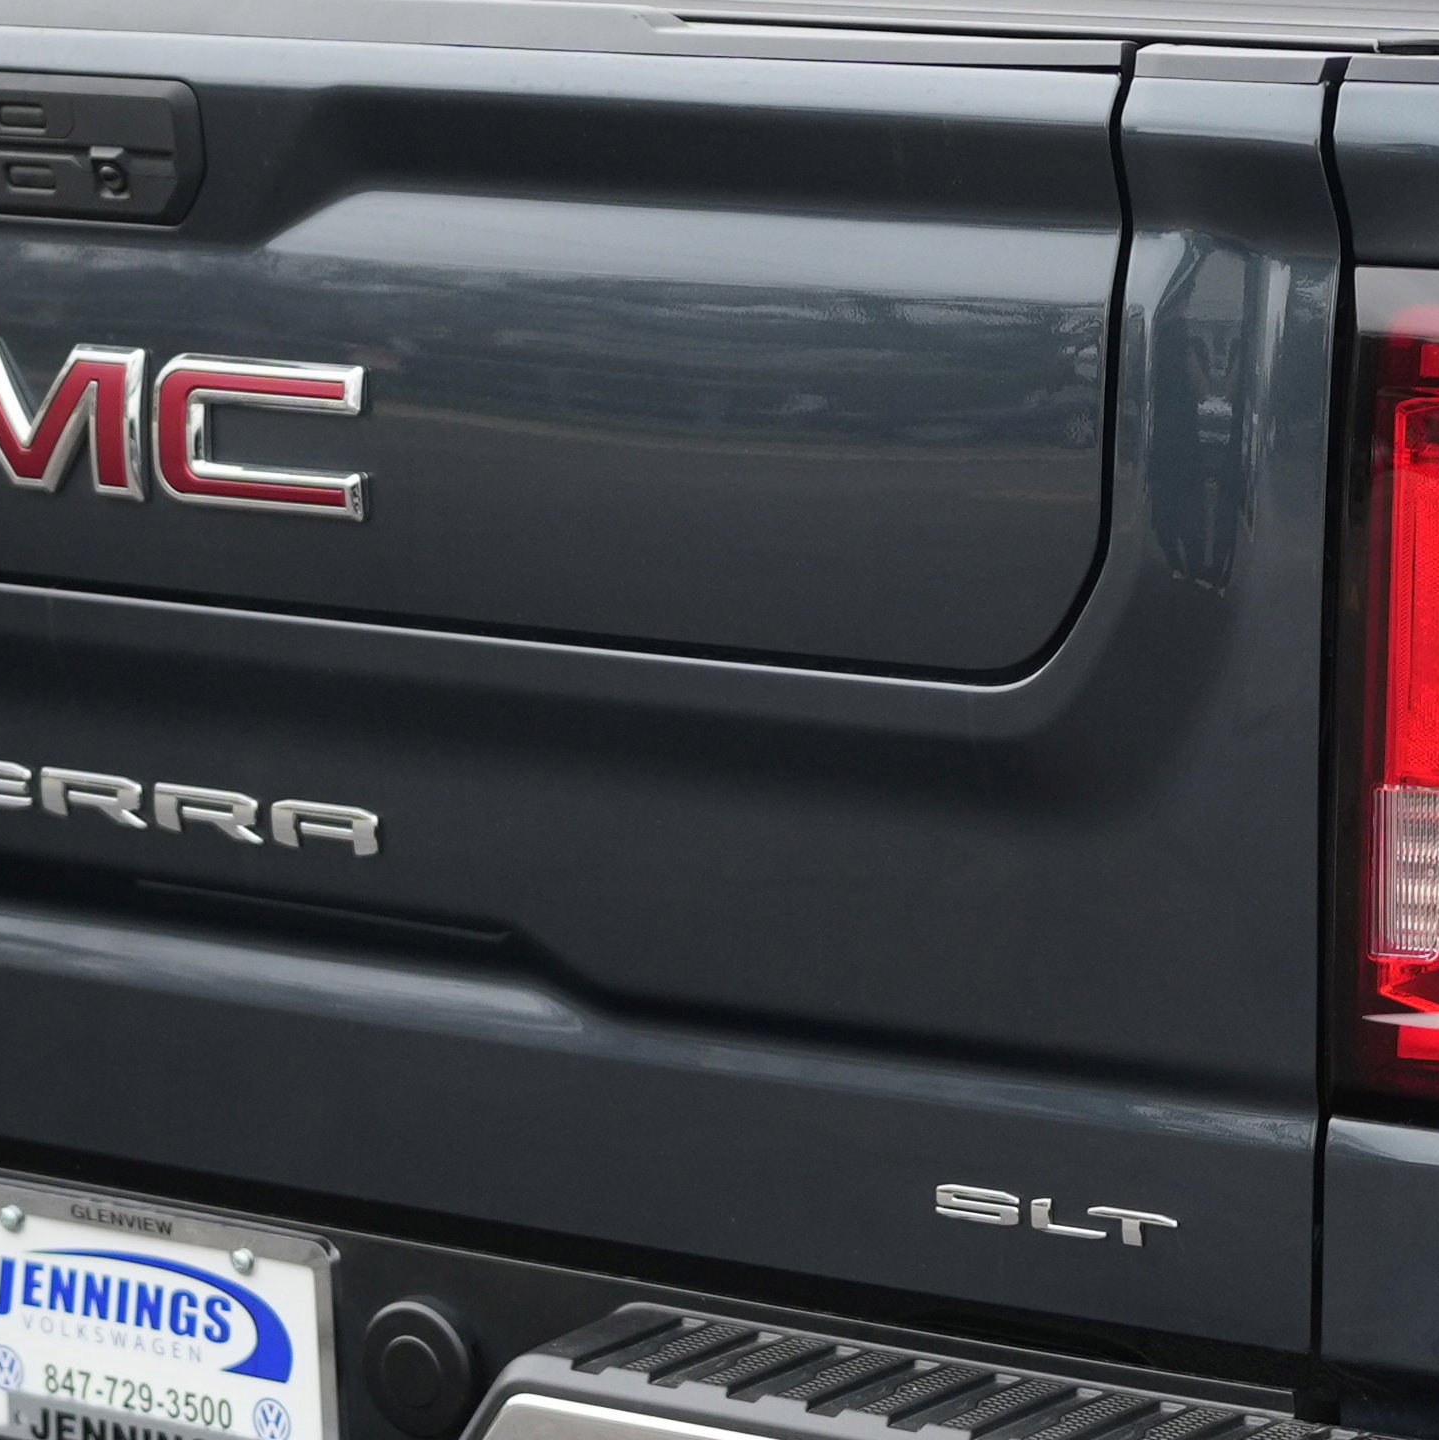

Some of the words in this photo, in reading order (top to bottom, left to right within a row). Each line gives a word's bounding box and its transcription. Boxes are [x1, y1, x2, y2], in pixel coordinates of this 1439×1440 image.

[70, 1204, 173, 1236] GLENVIEW
[936, 1184, 1178, 1247] SLT
[22, 1312, 203, 1364] VOLKSWAGEN
[44, 1363, 234, 1431] 847-729-3500
